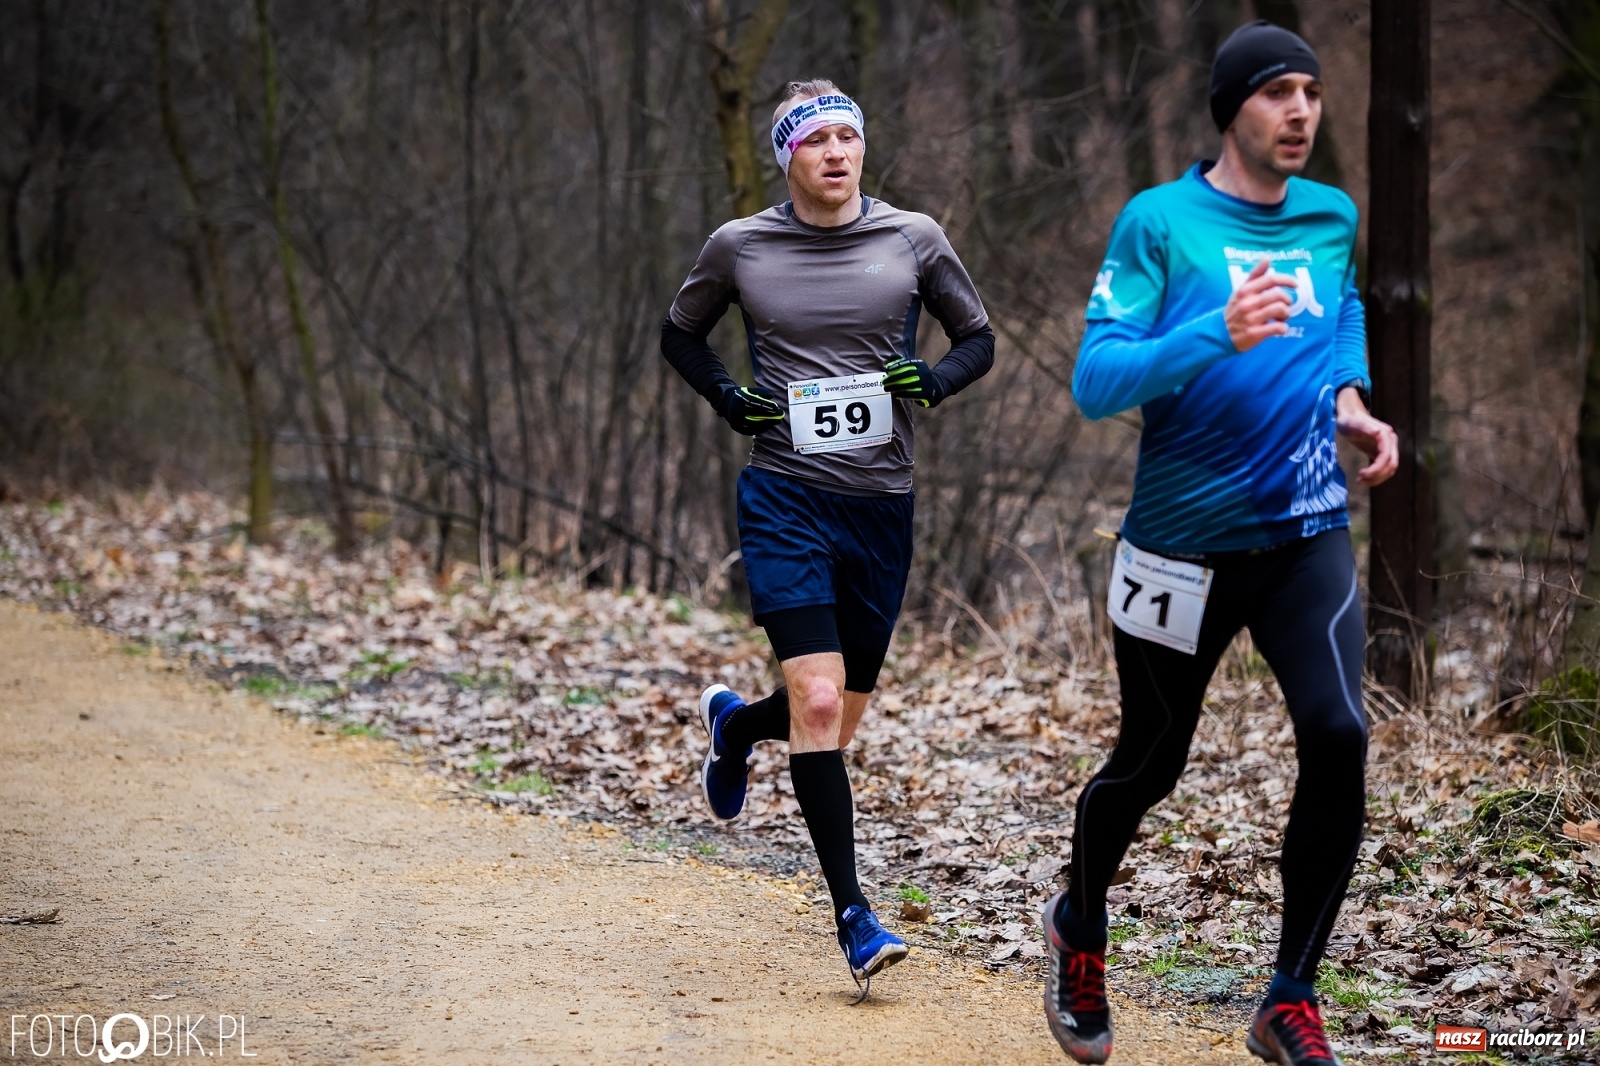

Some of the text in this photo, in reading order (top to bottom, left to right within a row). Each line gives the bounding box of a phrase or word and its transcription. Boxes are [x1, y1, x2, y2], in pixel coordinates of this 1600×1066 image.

[818, 95, 852, 106] Cross
[864, 264, 885, 275] 4F
[825, 381, 884, 392] www.personalbest.p
[814, 402, 871, 438] 59
[1122, 574, 1172, 629] 71
